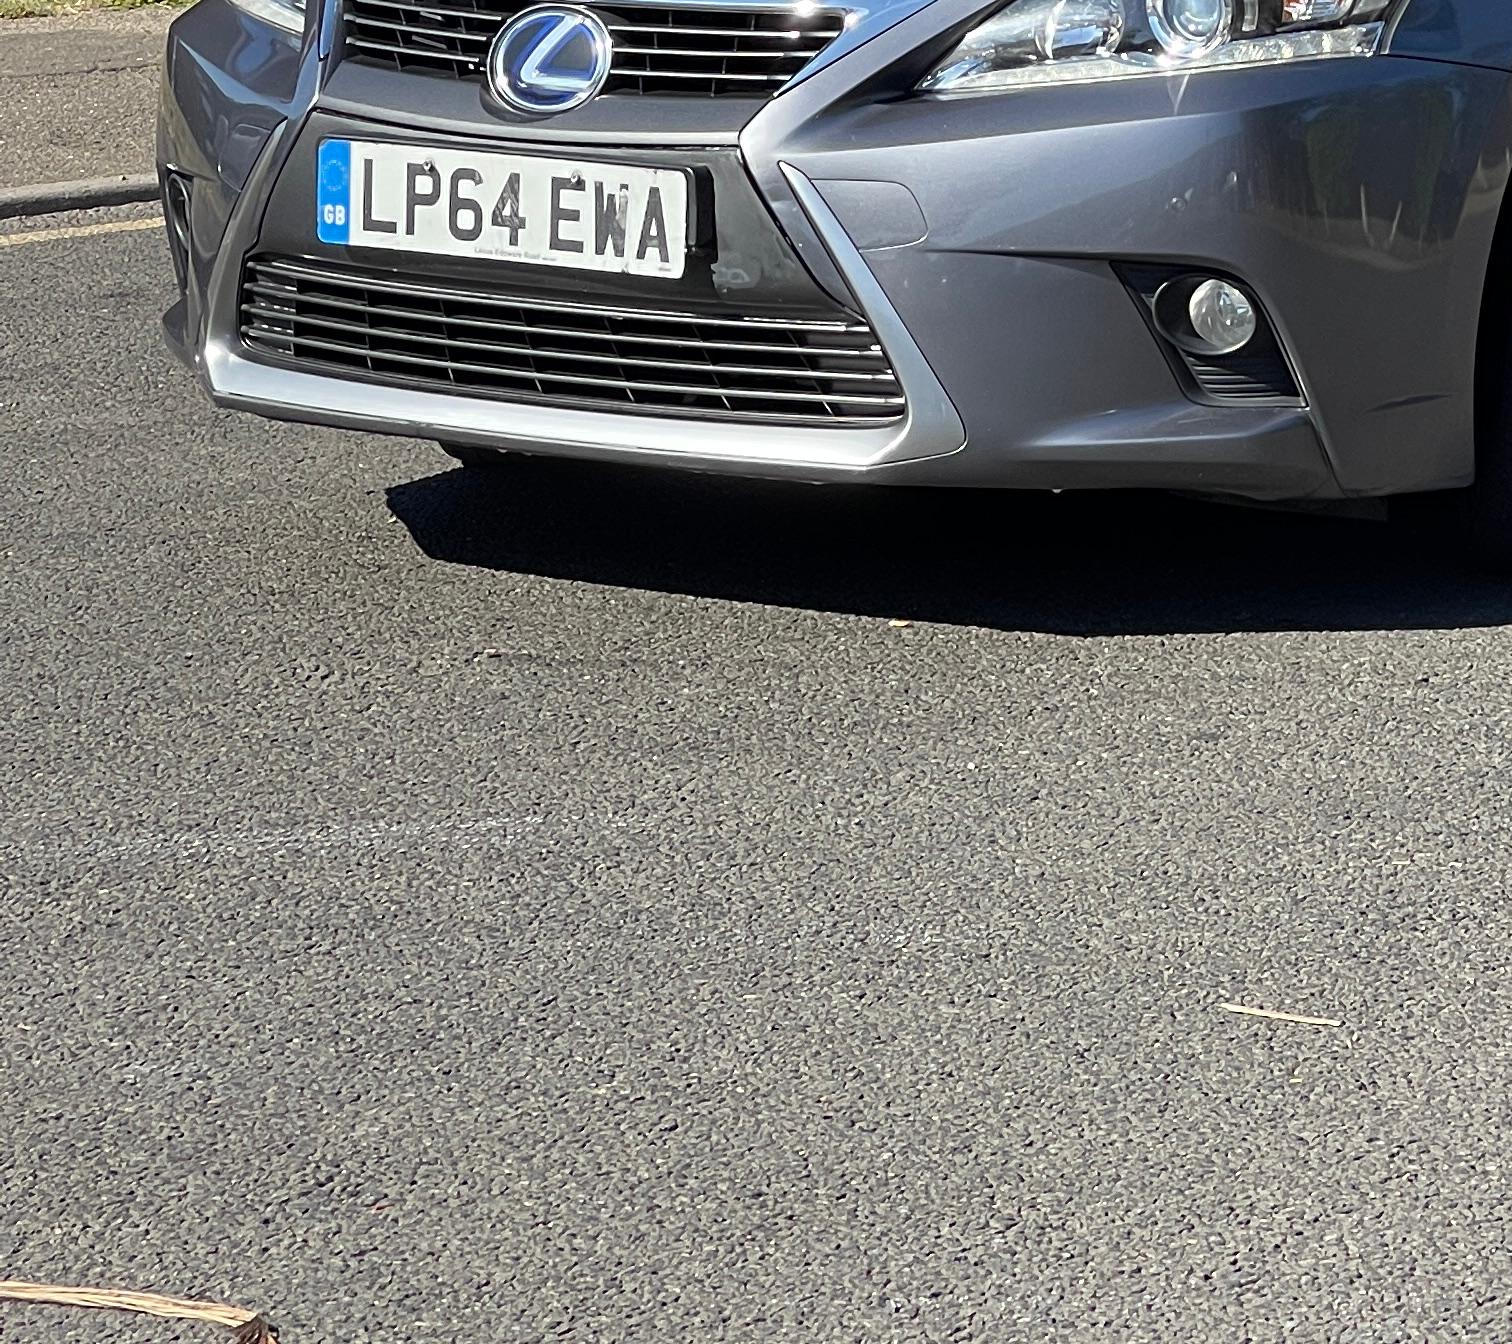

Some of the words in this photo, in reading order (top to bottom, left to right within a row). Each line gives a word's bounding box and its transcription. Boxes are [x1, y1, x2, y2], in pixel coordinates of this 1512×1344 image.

[323, 203, 346, 226] GB
[361, 157, 527, 247] LP64
[548, 174, 671, 264] EWA
